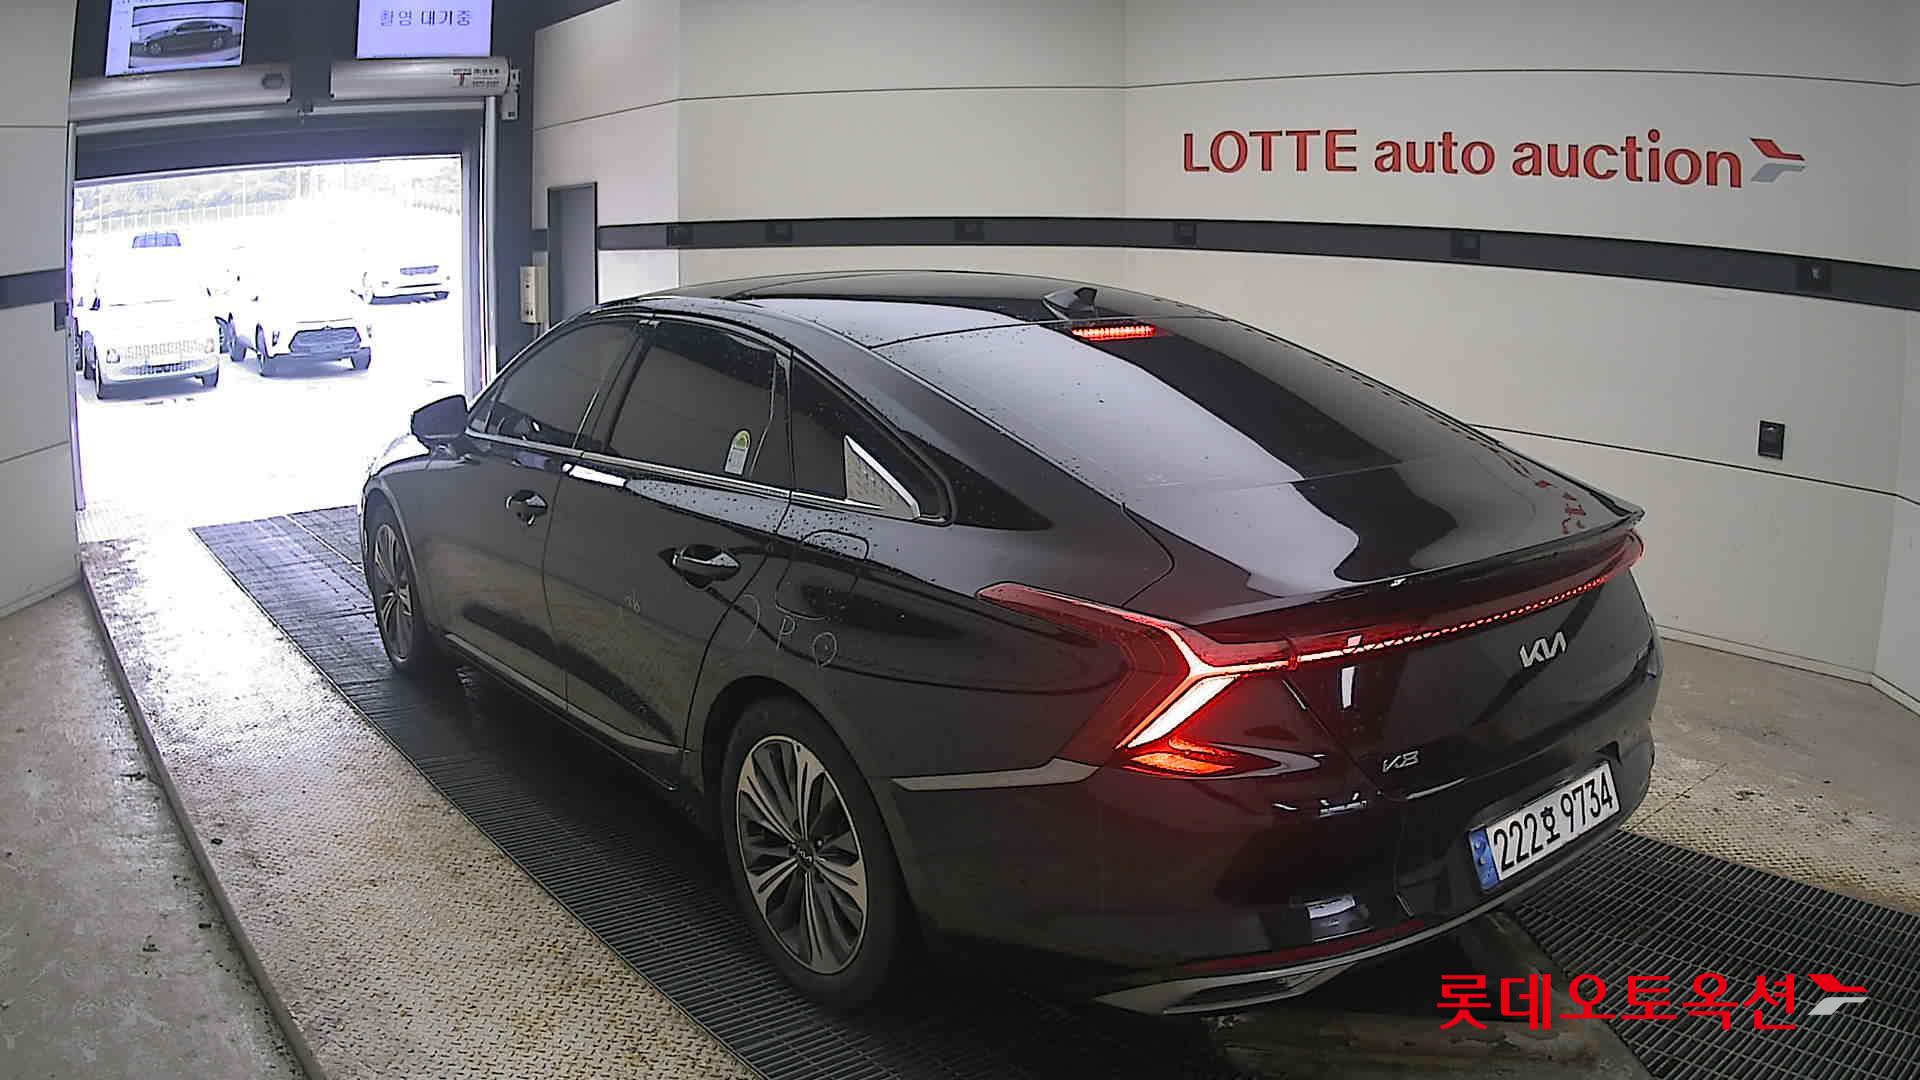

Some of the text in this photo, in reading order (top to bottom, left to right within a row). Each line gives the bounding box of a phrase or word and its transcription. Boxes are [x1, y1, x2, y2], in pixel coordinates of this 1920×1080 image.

[420, 9, 473, 27] 대기중
[1184, 129, 1742, 188] LOTTE auto auction
[1381, 750, 1420, 774] K8
